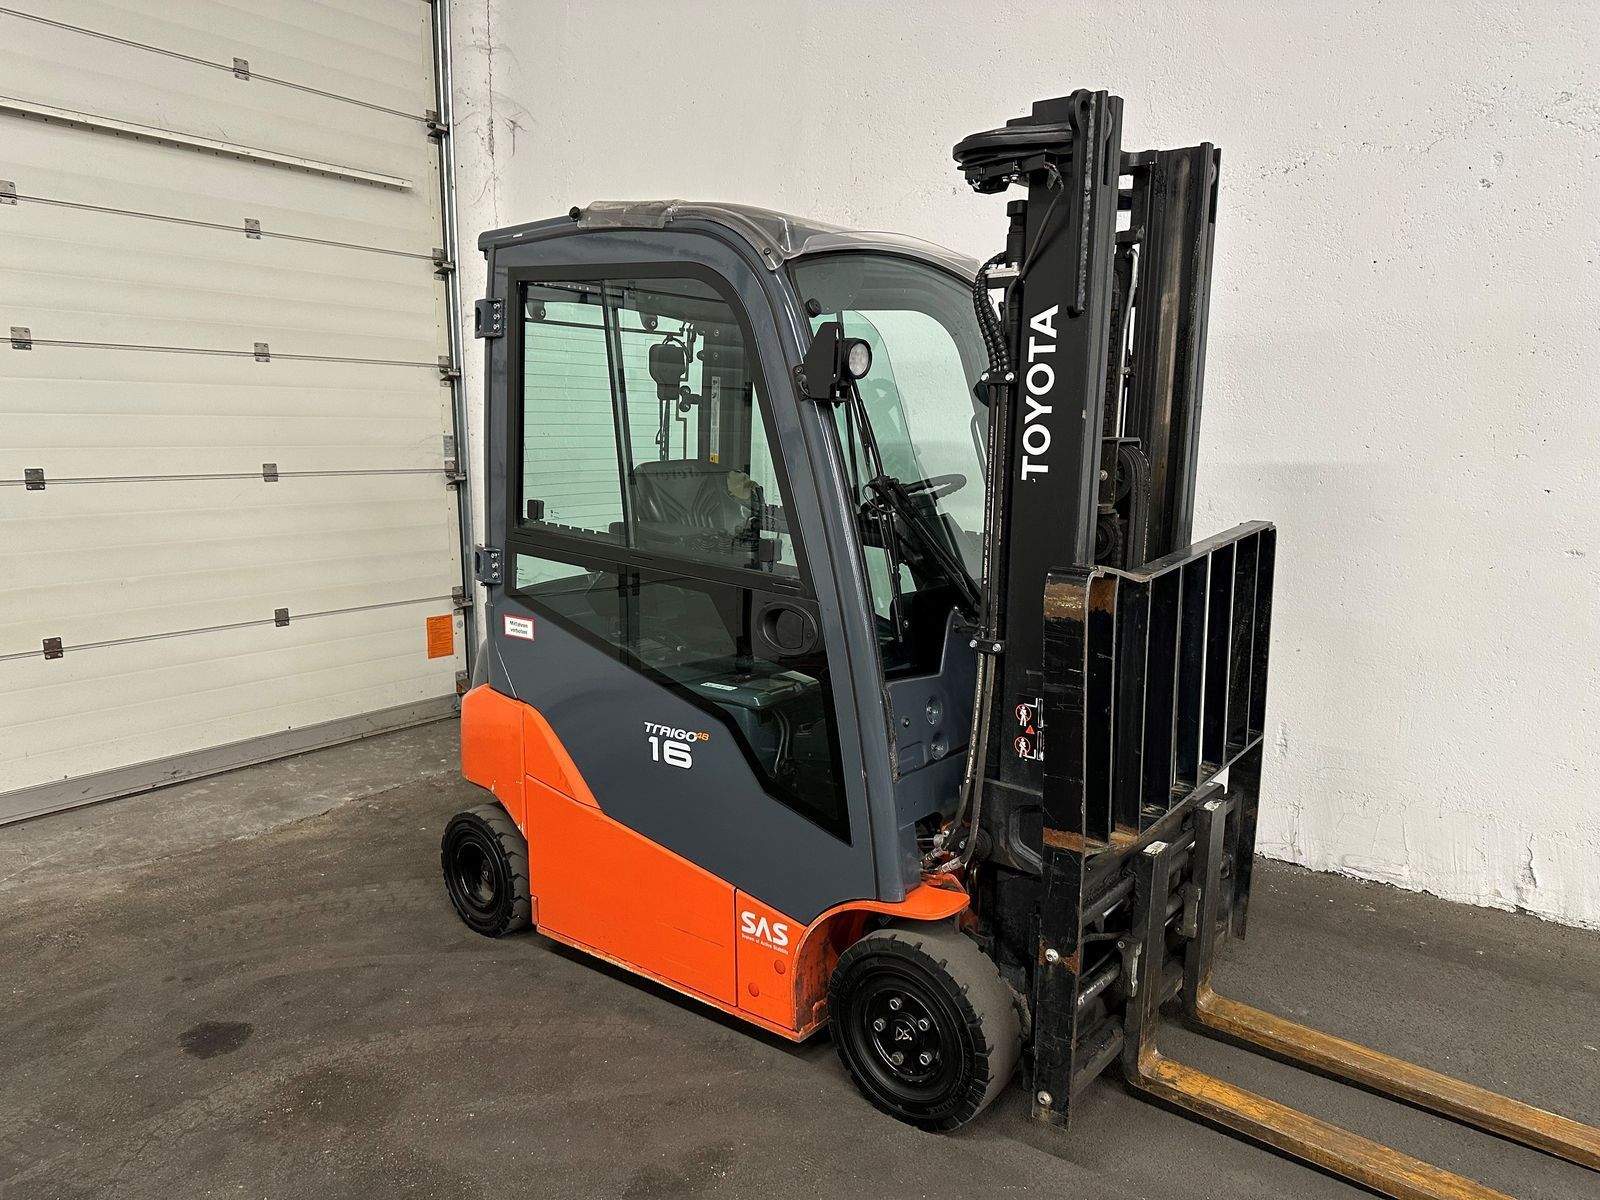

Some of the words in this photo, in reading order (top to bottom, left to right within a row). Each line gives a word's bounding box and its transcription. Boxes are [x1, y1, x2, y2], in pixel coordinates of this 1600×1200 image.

[1021, 304, 1059, 480] TOYOTA
[648, 736, 693, 769] 16
[696, 732, 710, 741] 48
[741, 911, 789, 946] SAS
